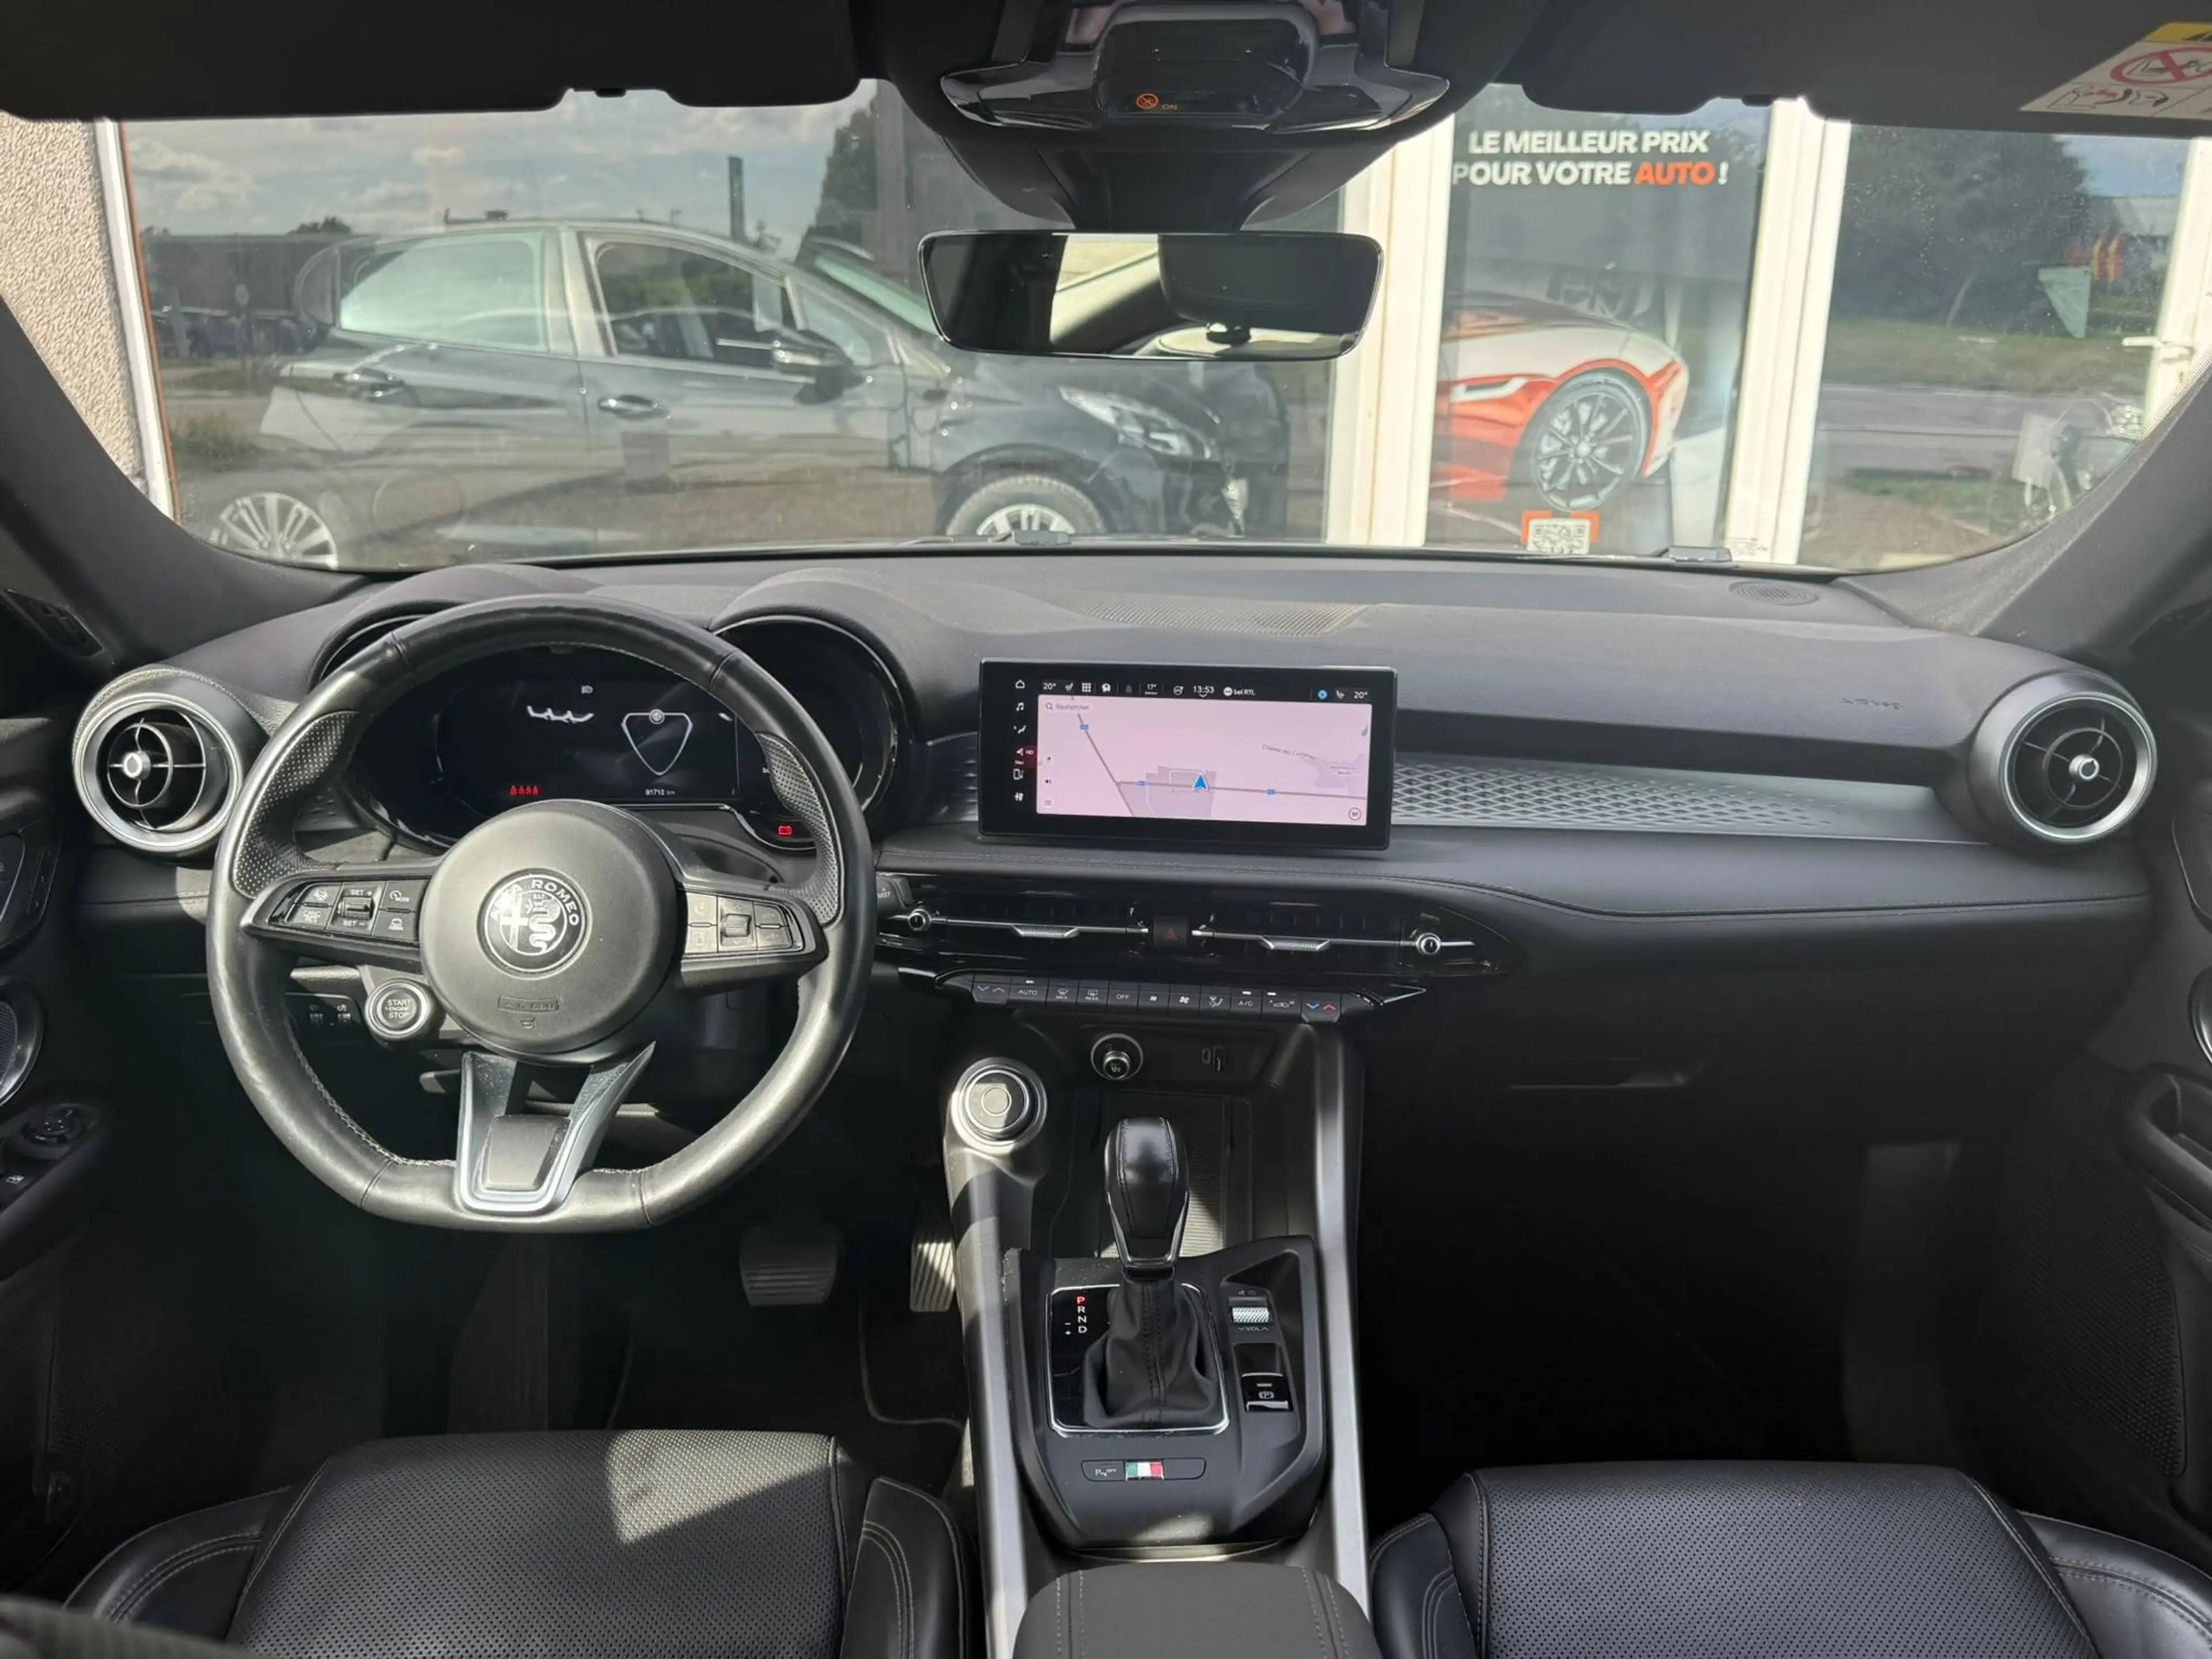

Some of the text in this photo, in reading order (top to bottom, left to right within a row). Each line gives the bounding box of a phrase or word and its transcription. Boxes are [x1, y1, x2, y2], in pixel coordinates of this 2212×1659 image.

[1468, 130, 1711, 154] LE MEILLEUR PRIX
[1452, 161, 1533, 185] POUR
[1535, 161, 1633, 185] VOTRE
[1193, 684, 1215, 694] 13:53
[531, 878, 580, 926] ROMEO
[387, 998, 413, 1007] START
[1076, 1296, 1086, 1305] P
[1077, 1305, 1086, 1314] R
[1077, 1315, 1088, 1324] N
[1078, 1325, 1088, 1334] D
